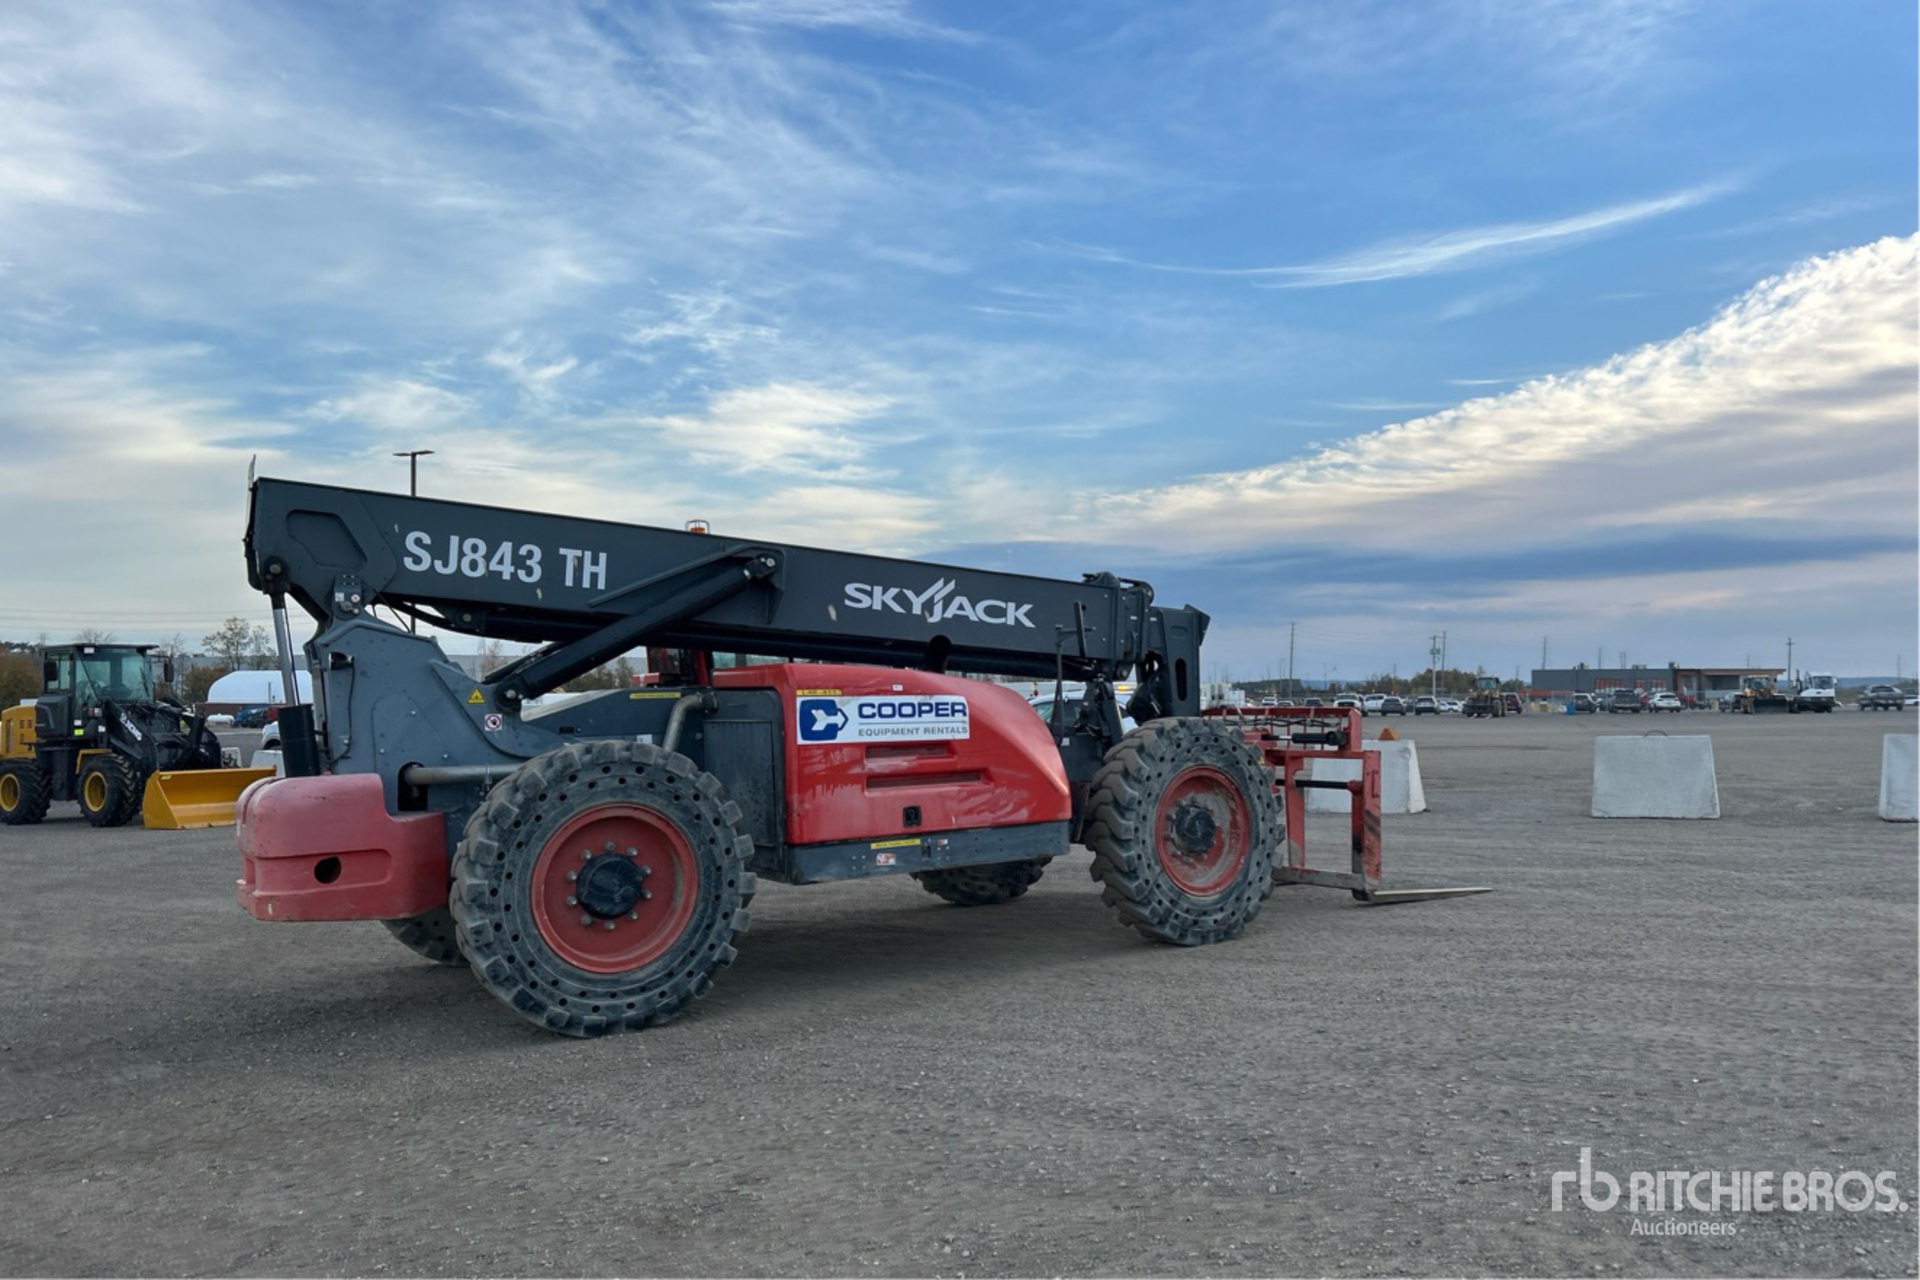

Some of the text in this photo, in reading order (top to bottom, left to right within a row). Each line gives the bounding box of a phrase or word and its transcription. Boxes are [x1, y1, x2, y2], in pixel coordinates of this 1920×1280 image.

[403, 530, 608, 590] SJ843 TH
[844, 577, 1036, 628] SKYJACK
[858, 702, 967, 719] COOPER
[858, 725, 969, 737] EQUIPMENT RENTALS
